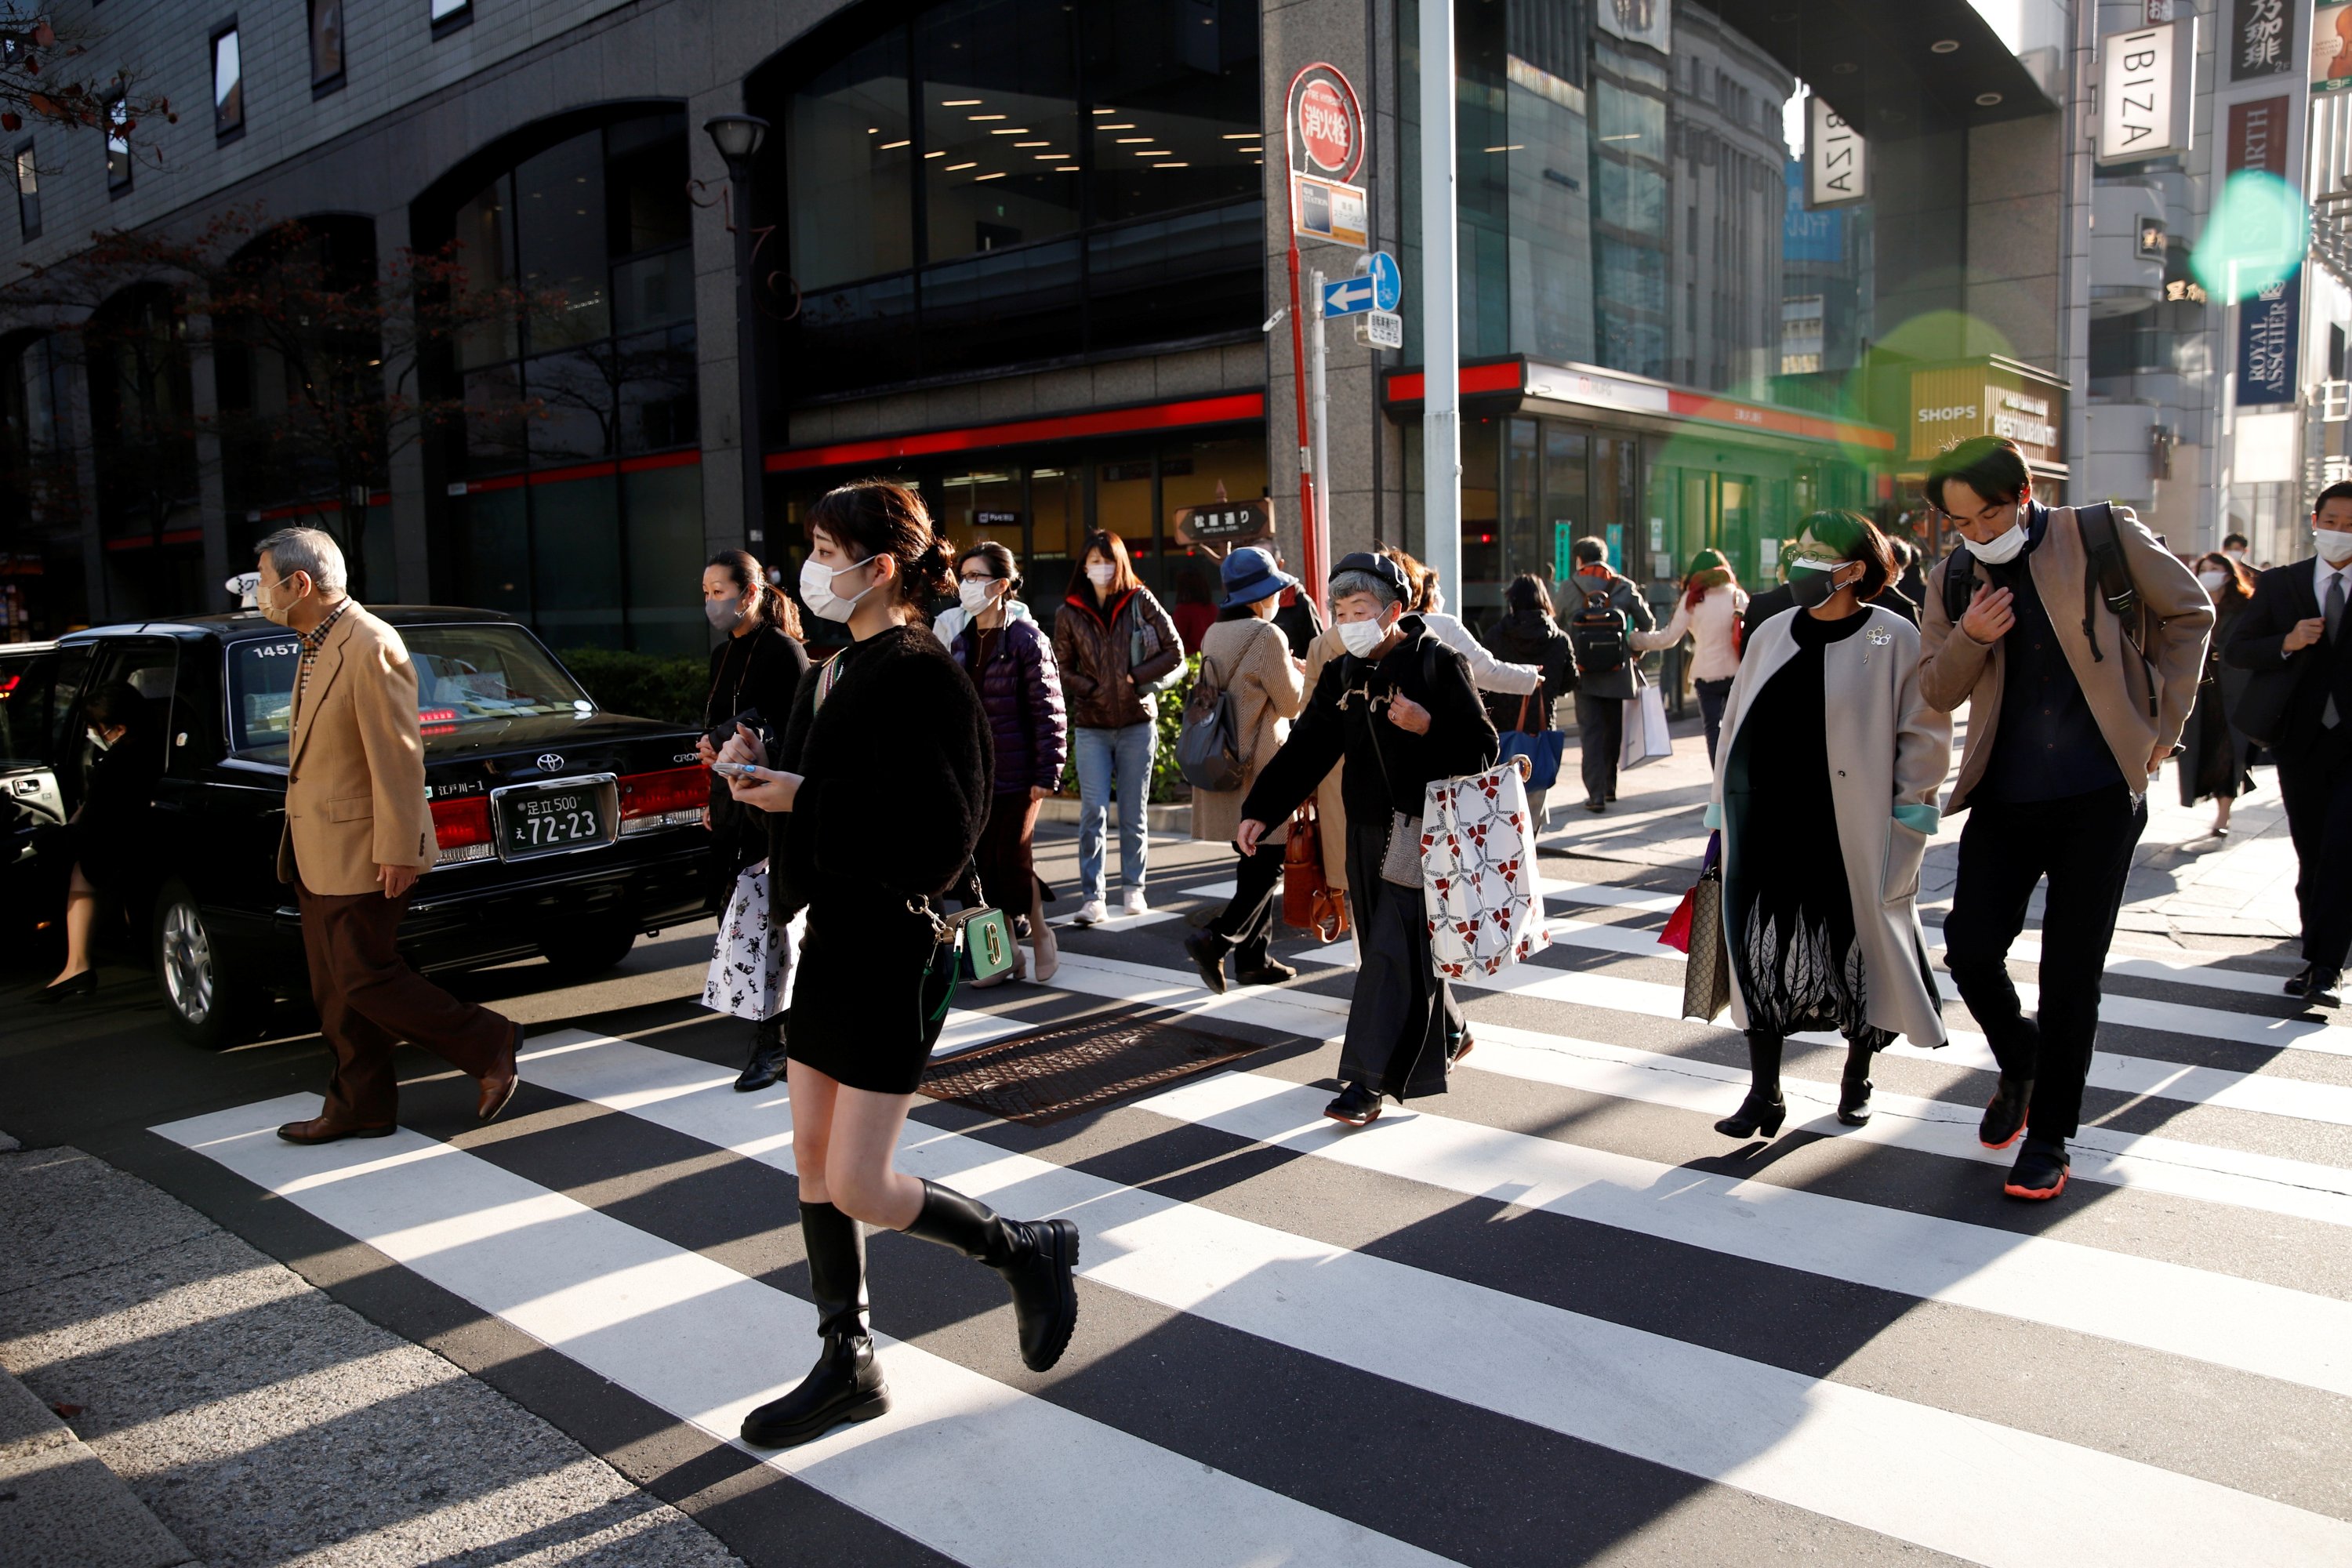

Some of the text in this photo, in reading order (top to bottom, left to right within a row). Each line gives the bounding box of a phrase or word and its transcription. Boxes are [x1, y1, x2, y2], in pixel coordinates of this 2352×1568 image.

[2274, 61, 2290, 73] 2F
[2122, 32, 2156, 146] IBIZA
[1305, 103, 1348, 147] 消火栓
[1372, 328, 1399, 343] ここから
[2249, 315, 2268, 382] ROYAL
[2266, 301, 2287, 394] ASSCHER
[1918, 405, 1977, 423] SHOPS
[253, 643, 299, 659] 1457
[516, 811, 597, 844] え 72-23
